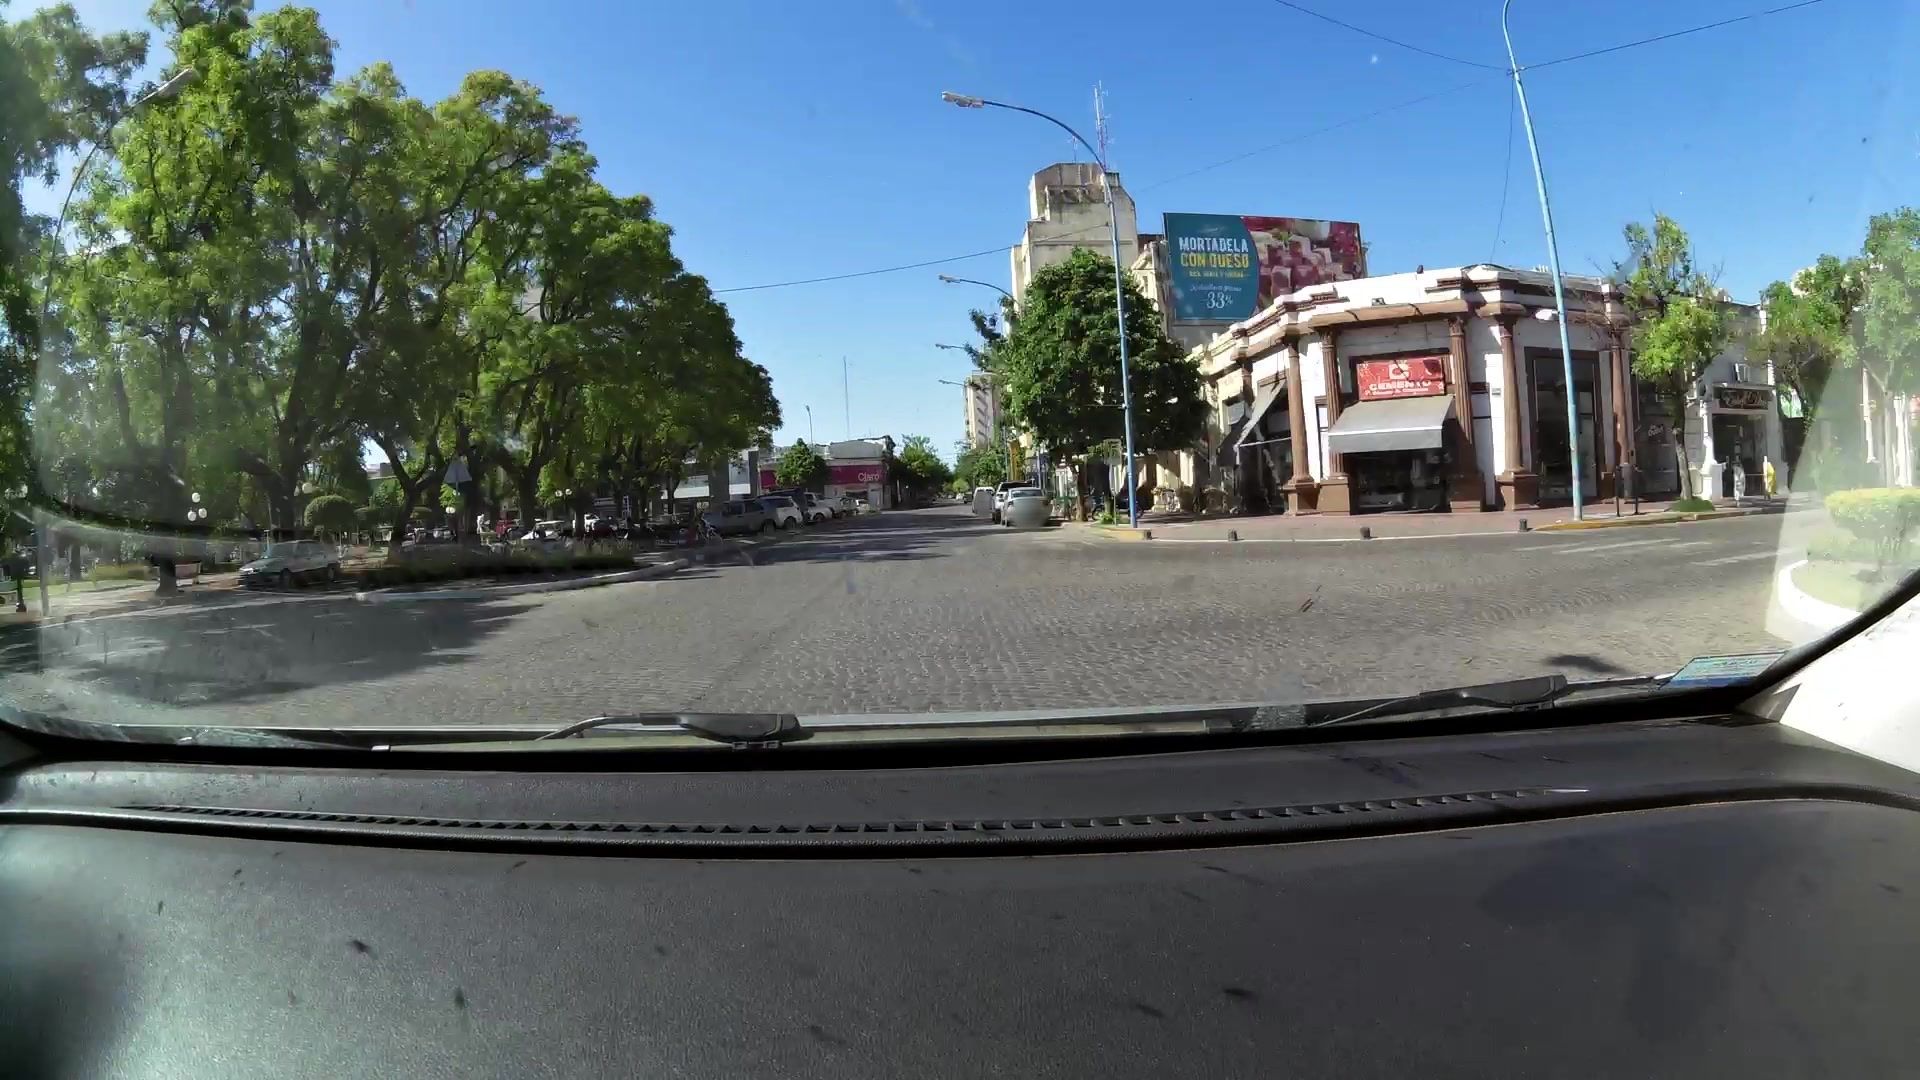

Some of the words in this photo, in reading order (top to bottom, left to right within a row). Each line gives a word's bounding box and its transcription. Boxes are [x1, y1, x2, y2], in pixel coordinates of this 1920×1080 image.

[1179, 237, 1249, 252] MORTADELA
[1181, 253, 1205, 268] CON
[1208, 253, 1249, 269] QUESO
[858, 471, 880, 482] Claro
